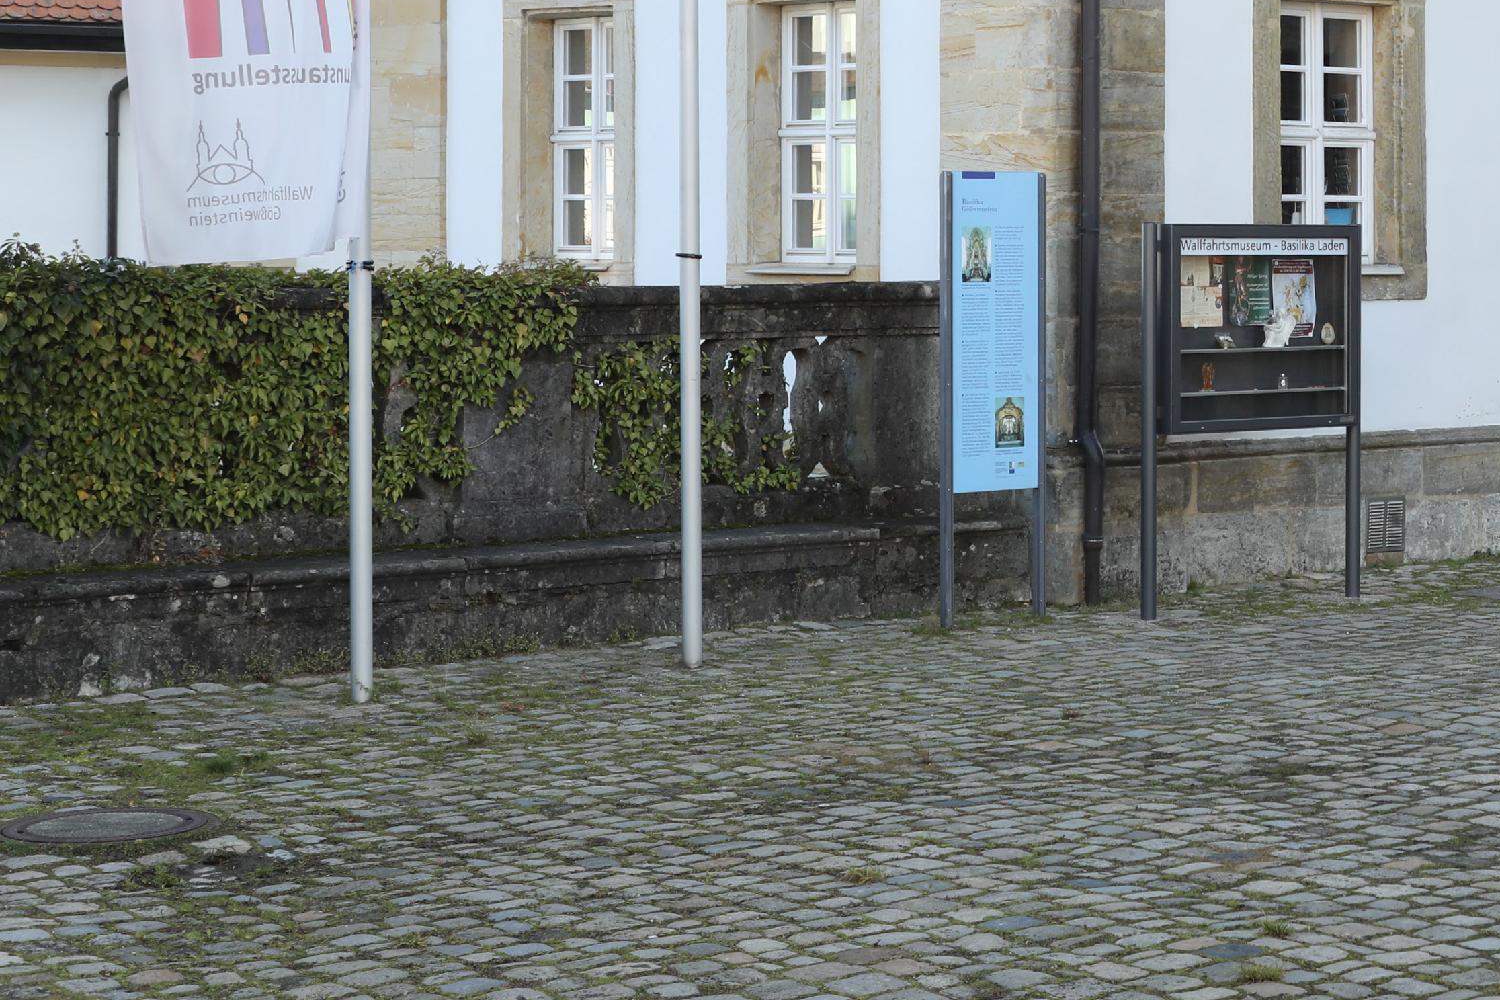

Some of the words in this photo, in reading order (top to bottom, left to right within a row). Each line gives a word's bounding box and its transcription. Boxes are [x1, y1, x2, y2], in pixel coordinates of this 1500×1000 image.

[1180, 239, 1271, 251] Wallfahrtsmuseum
[1281, 239, 1315, 251] Basilika
[1317, 239, 1345, 251] Laden
